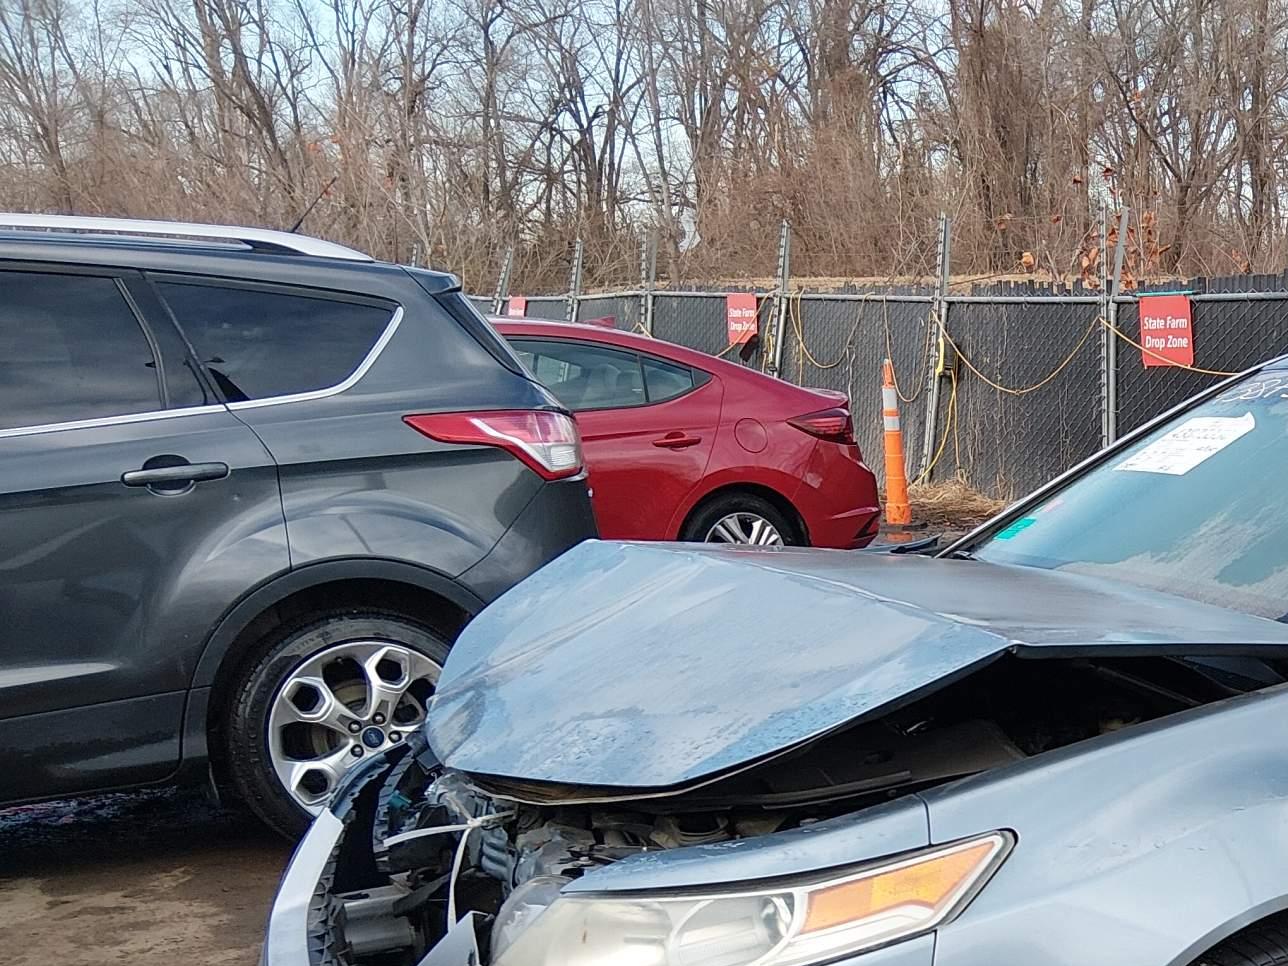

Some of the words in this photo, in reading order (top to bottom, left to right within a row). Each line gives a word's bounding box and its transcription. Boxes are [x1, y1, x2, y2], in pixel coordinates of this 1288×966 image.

[1143, 316, 1165, 330] State
[1166, 315, 1188, 329] Farm
[1145, 335, 1165, 351] Drop
[1167, 334, 1189, 348] Zone
